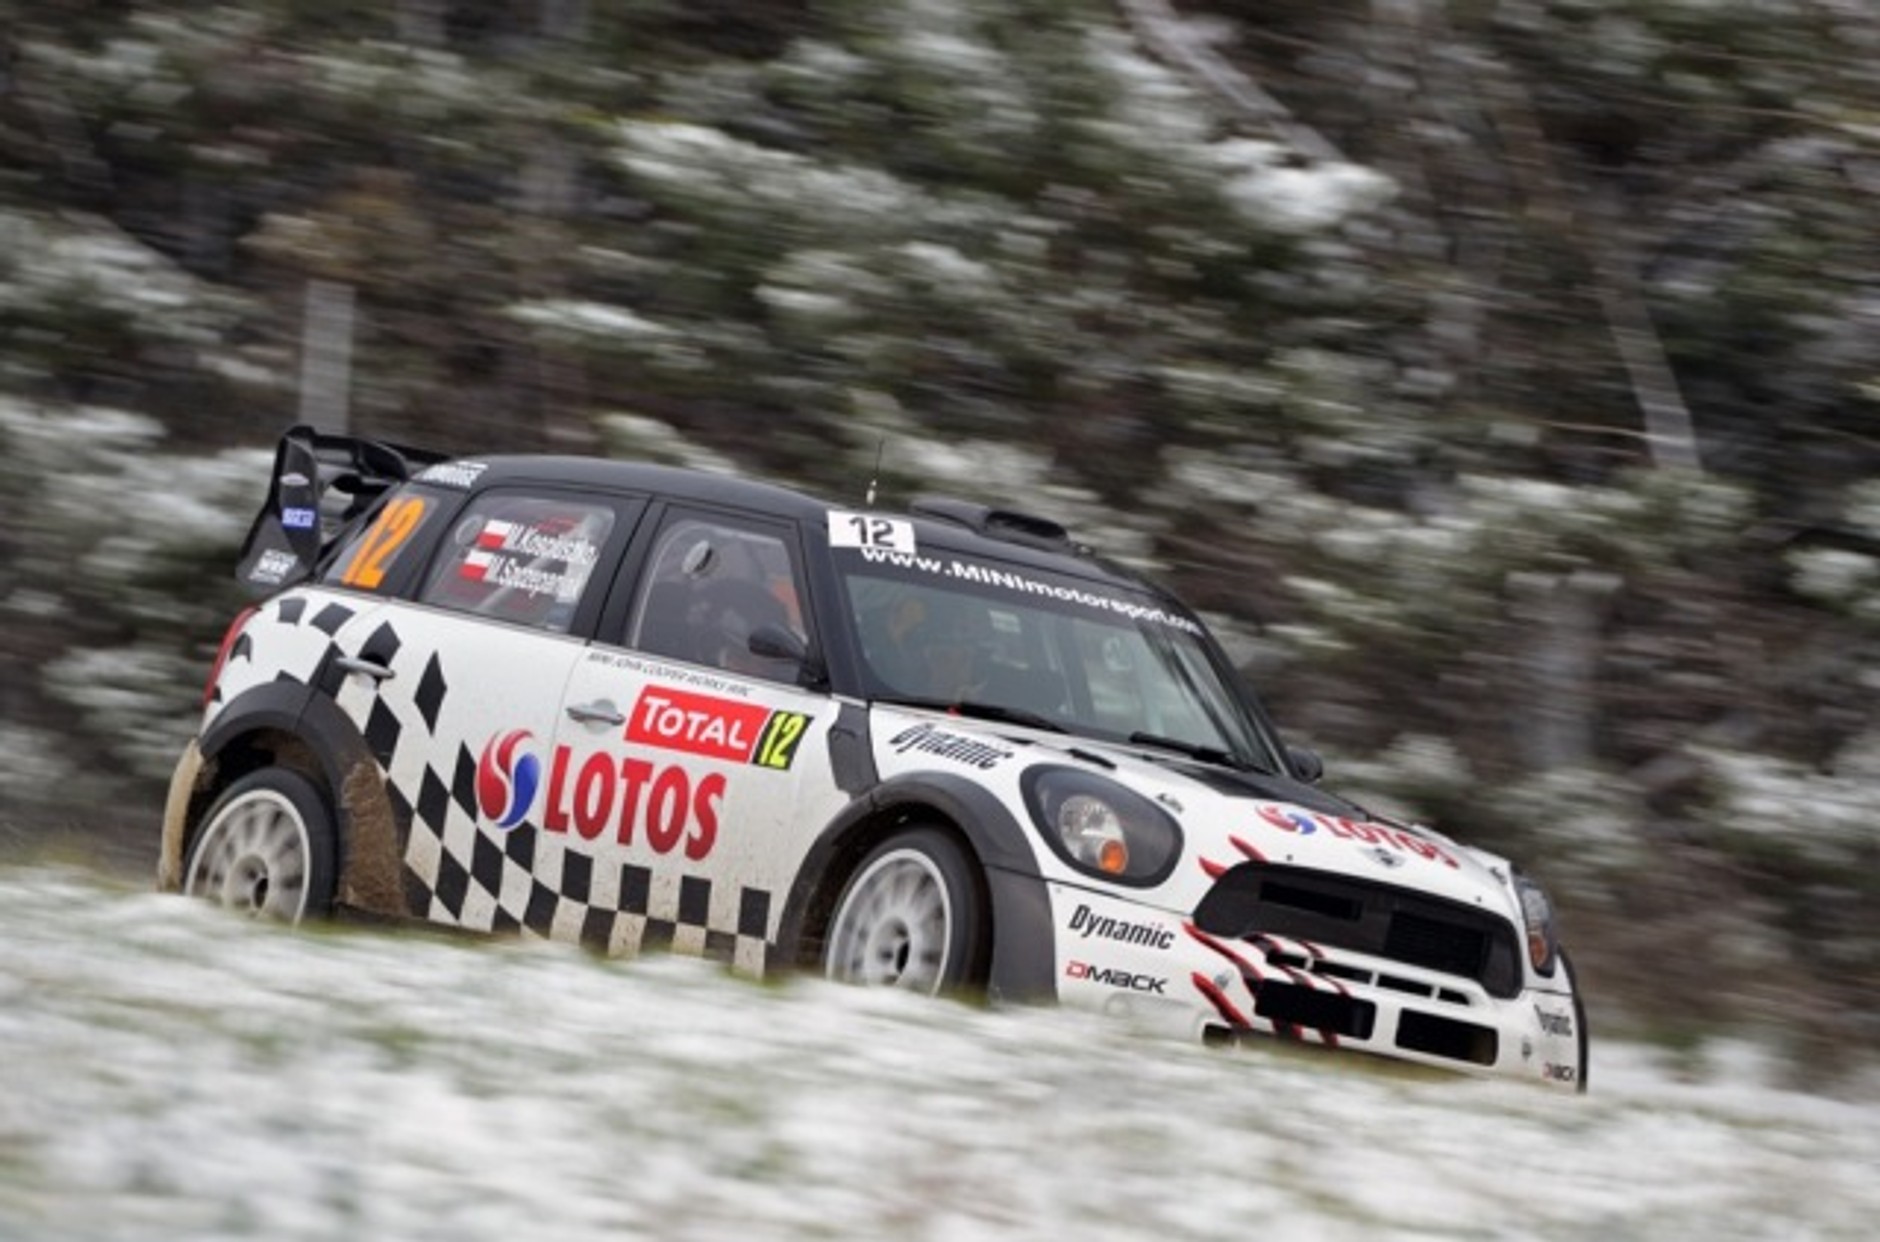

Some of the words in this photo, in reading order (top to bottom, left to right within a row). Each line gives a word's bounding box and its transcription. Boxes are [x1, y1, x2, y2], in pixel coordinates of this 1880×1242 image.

[341, 496, 426, 588] 12
[849, 516, 895, 547] 12
[759, 711, 807, 767] 12
[889, 722, 1014, 771] Dynamic
[544, 744, 727, 861] LOTOS
[1314, 813, 1461, 870] LOTOS
[1068, 904, 1175, 950] Dynamic
